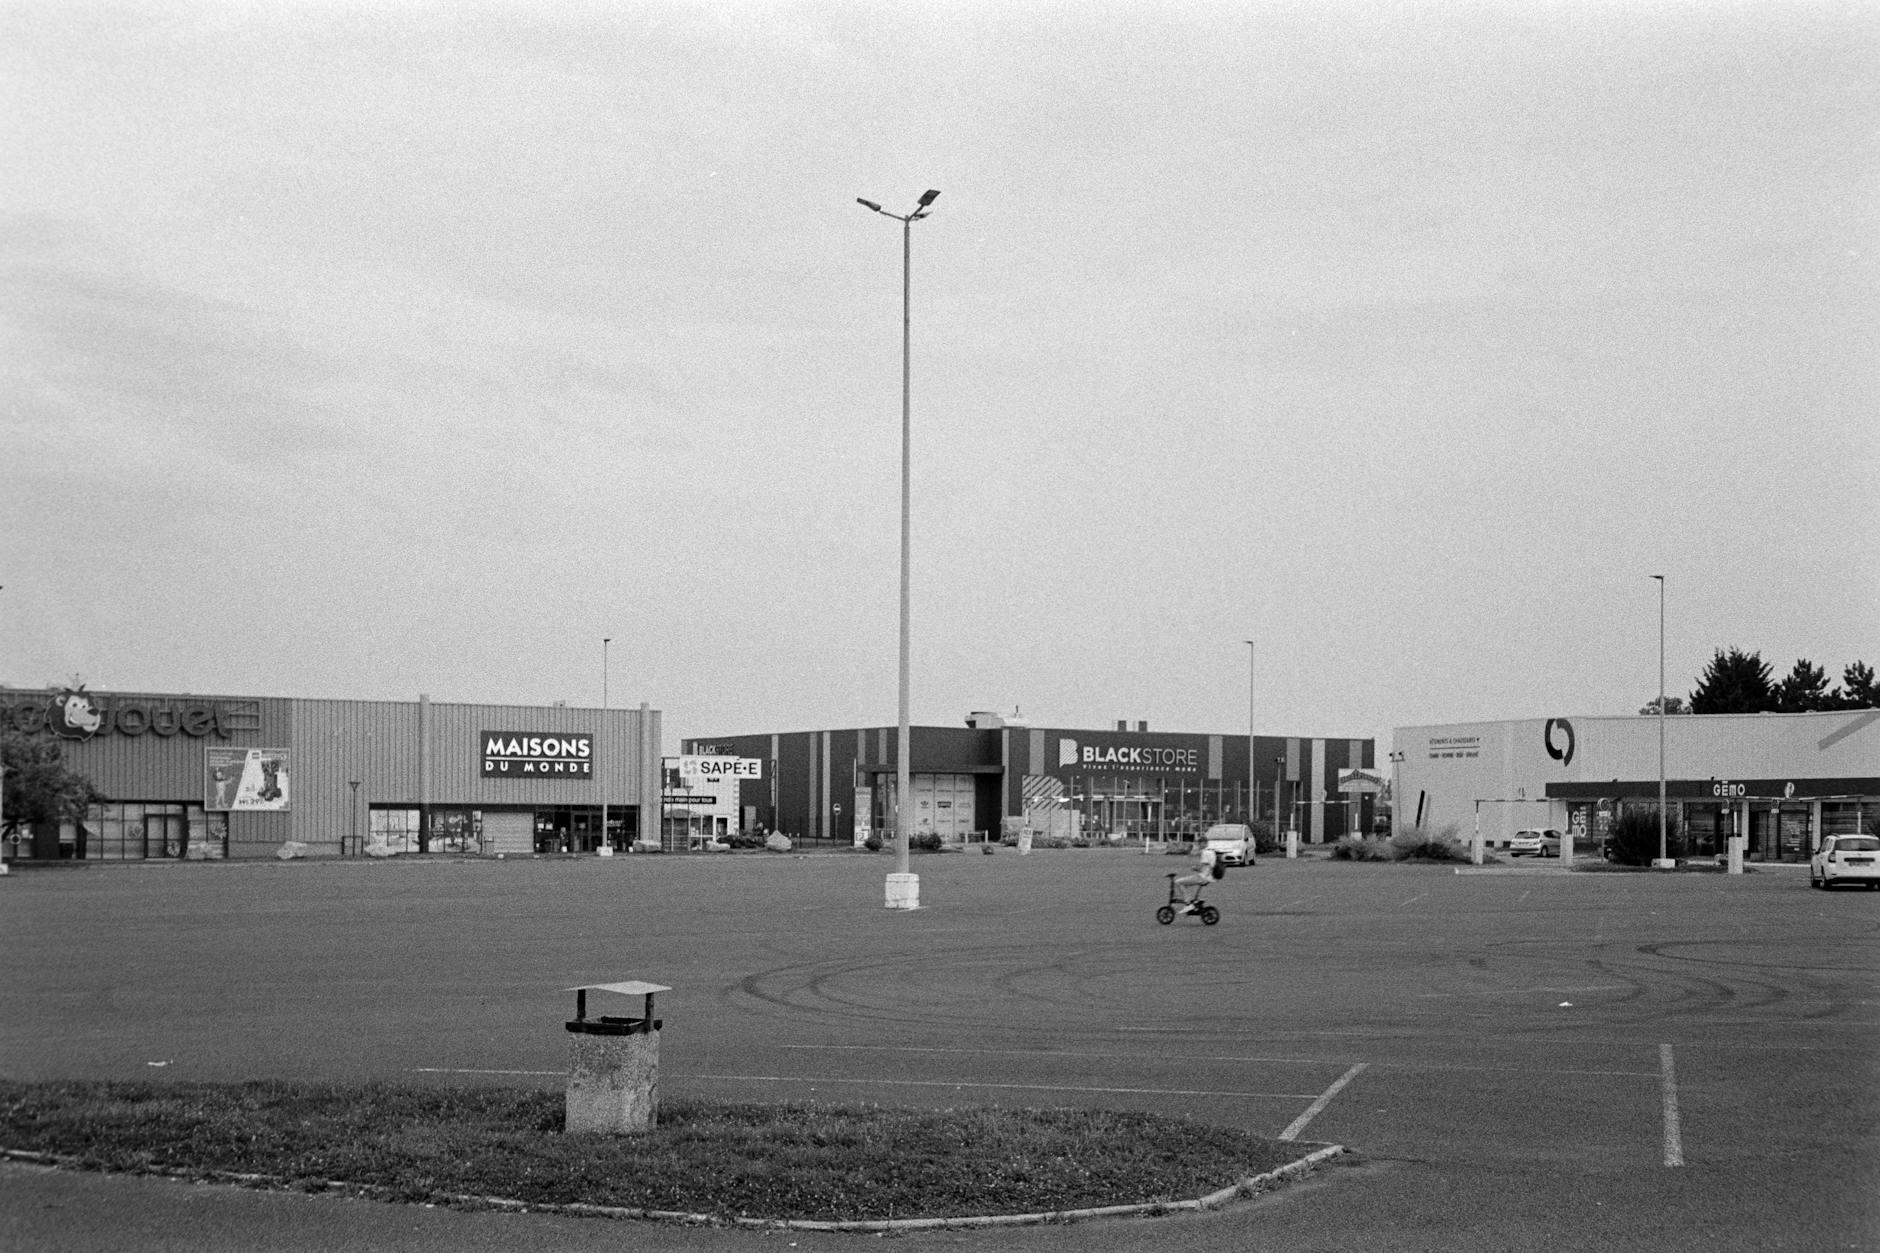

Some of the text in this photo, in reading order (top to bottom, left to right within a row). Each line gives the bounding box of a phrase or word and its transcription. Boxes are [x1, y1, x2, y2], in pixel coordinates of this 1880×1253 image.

[485, 737, 590, 757] MAISONS
[1082, 746, 1197, 765] BLACKSTORE
[485, 761, 590, 773] DU MONDE
